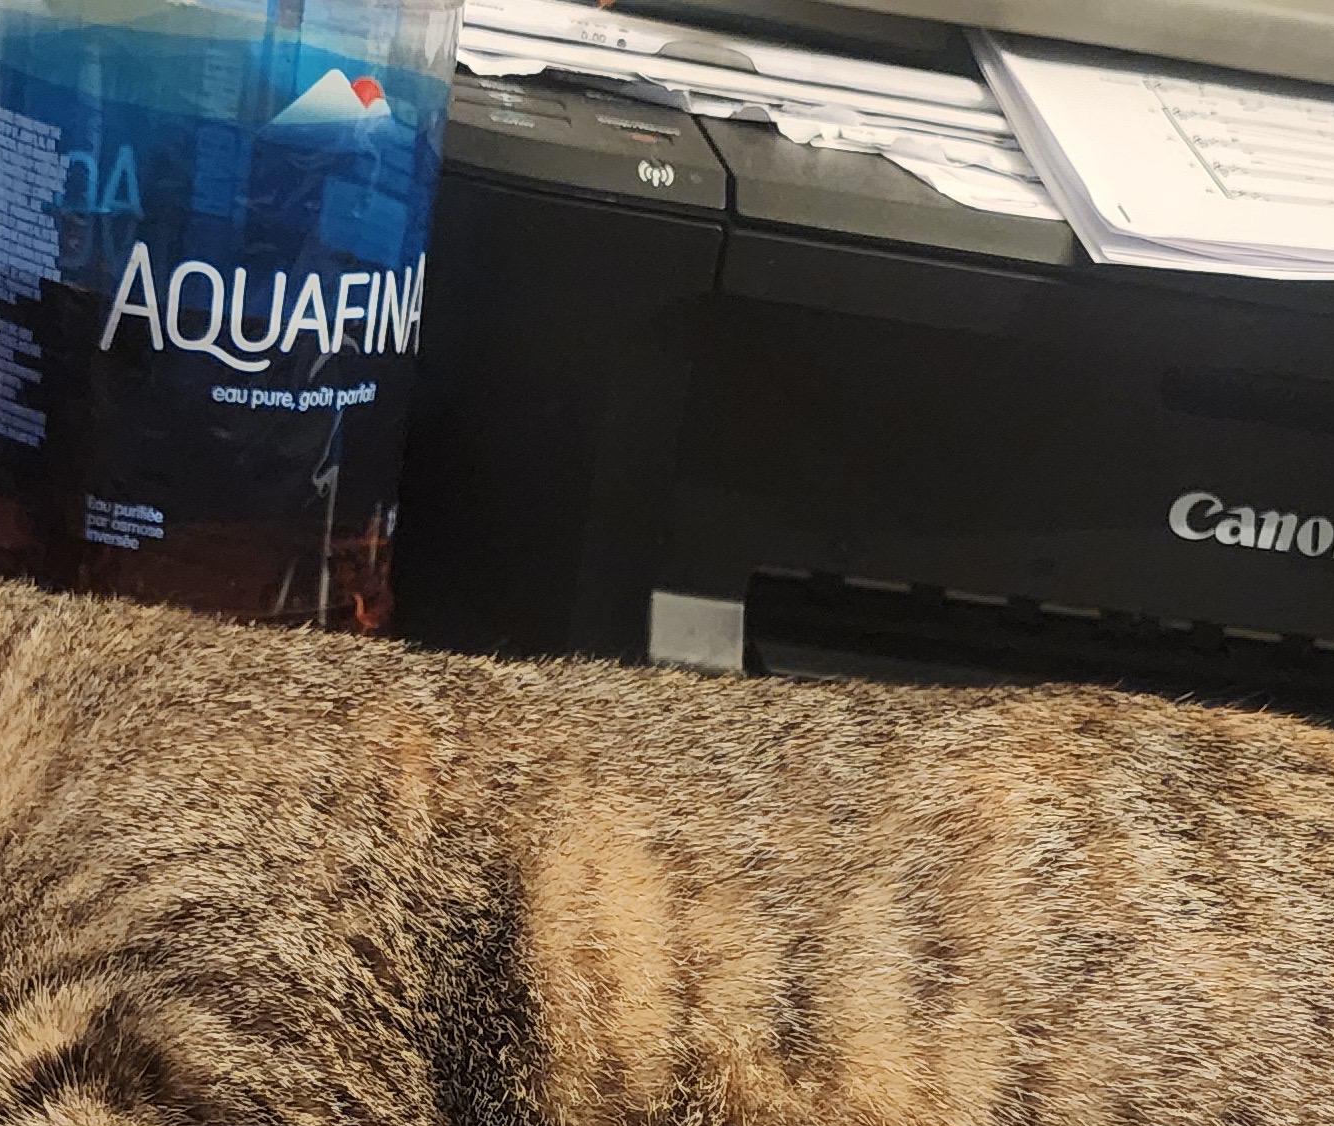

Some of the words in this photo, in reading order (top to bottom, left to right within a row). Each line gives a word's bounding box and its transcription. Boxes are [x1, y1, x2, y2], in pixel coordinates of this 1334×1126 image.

[100, 241, 425, 372] AQUAFINA
[212, 386, 248, 403] eau
[250, 389, 295, 410] pure,
[298, 386, 334, 411] goût
[336, 381, 377, 411] parfait
